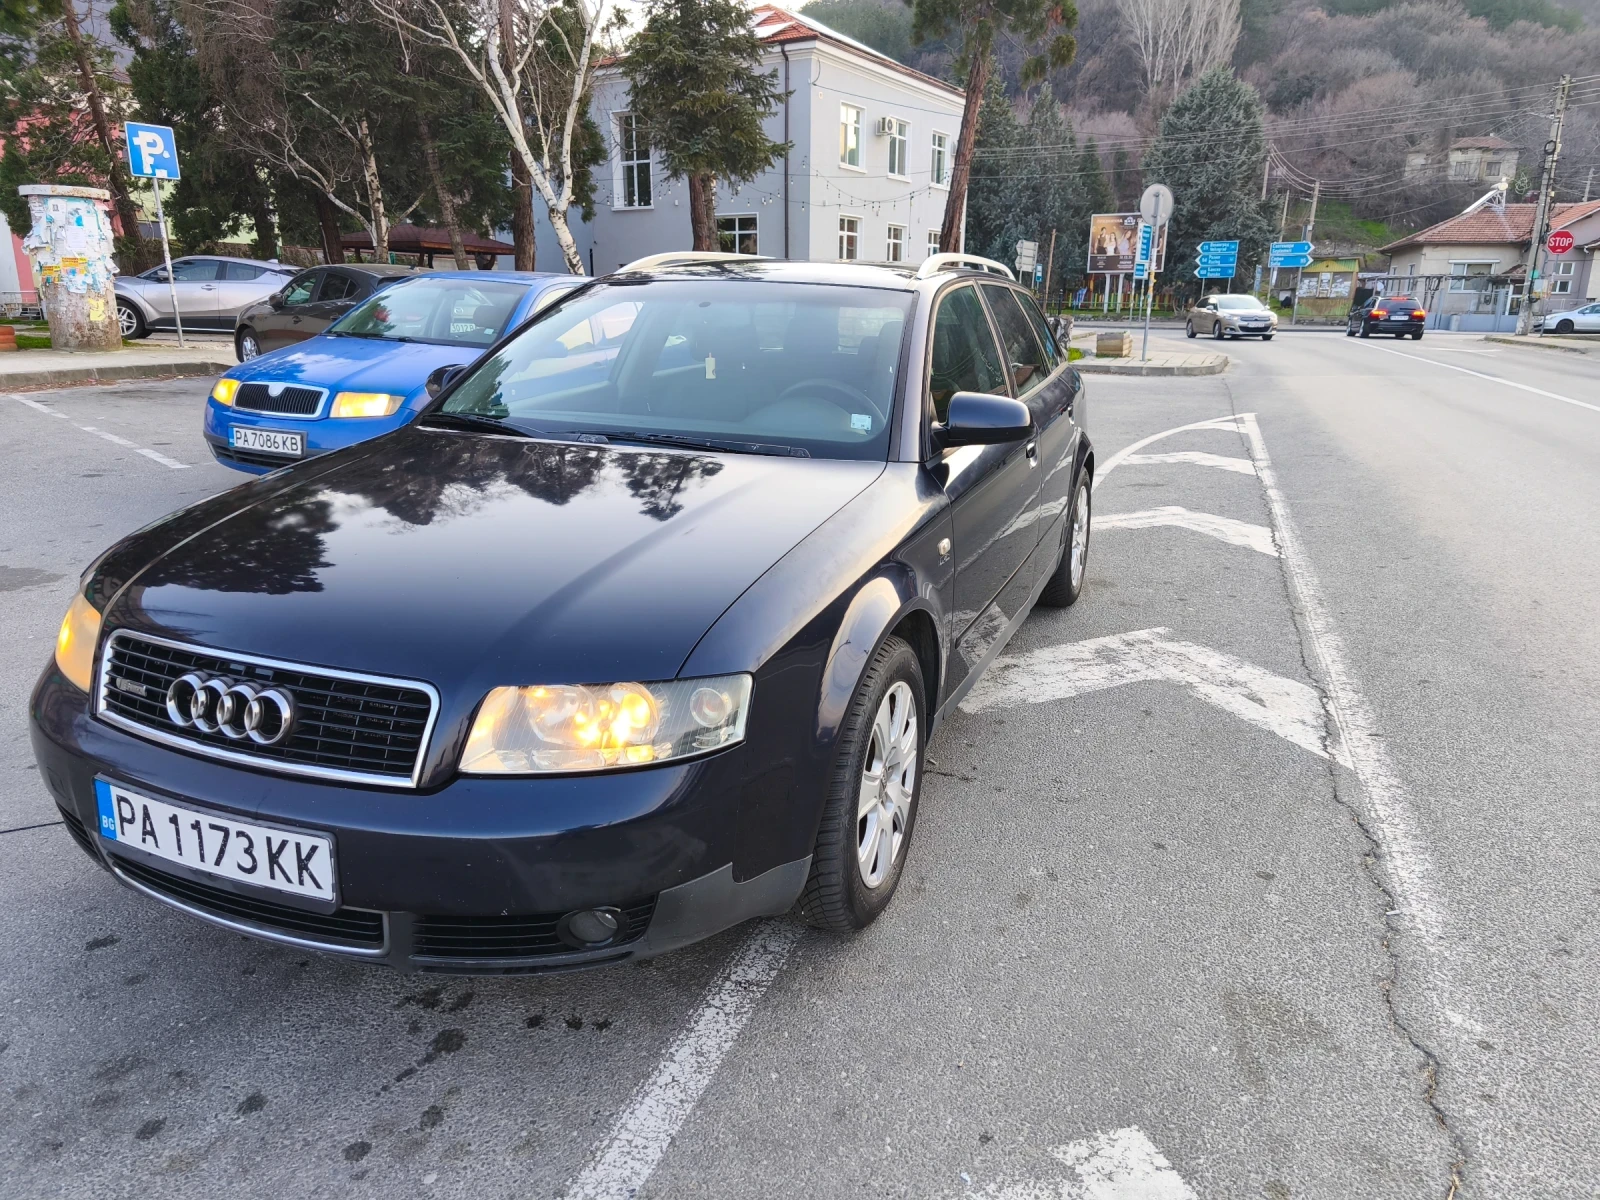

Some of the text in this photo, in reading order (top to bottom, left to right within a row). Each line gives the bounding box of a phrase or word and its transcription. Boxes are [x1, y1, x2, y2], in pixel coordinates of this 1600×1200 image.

[137, 130, 165, 174] P
[1548, 236, 1573, 247] STOP
[235, 430, 299, 452] PA7086KB
[102, 815, 115, 831] BG
[116, 794, 324, 890] PA1173KK
